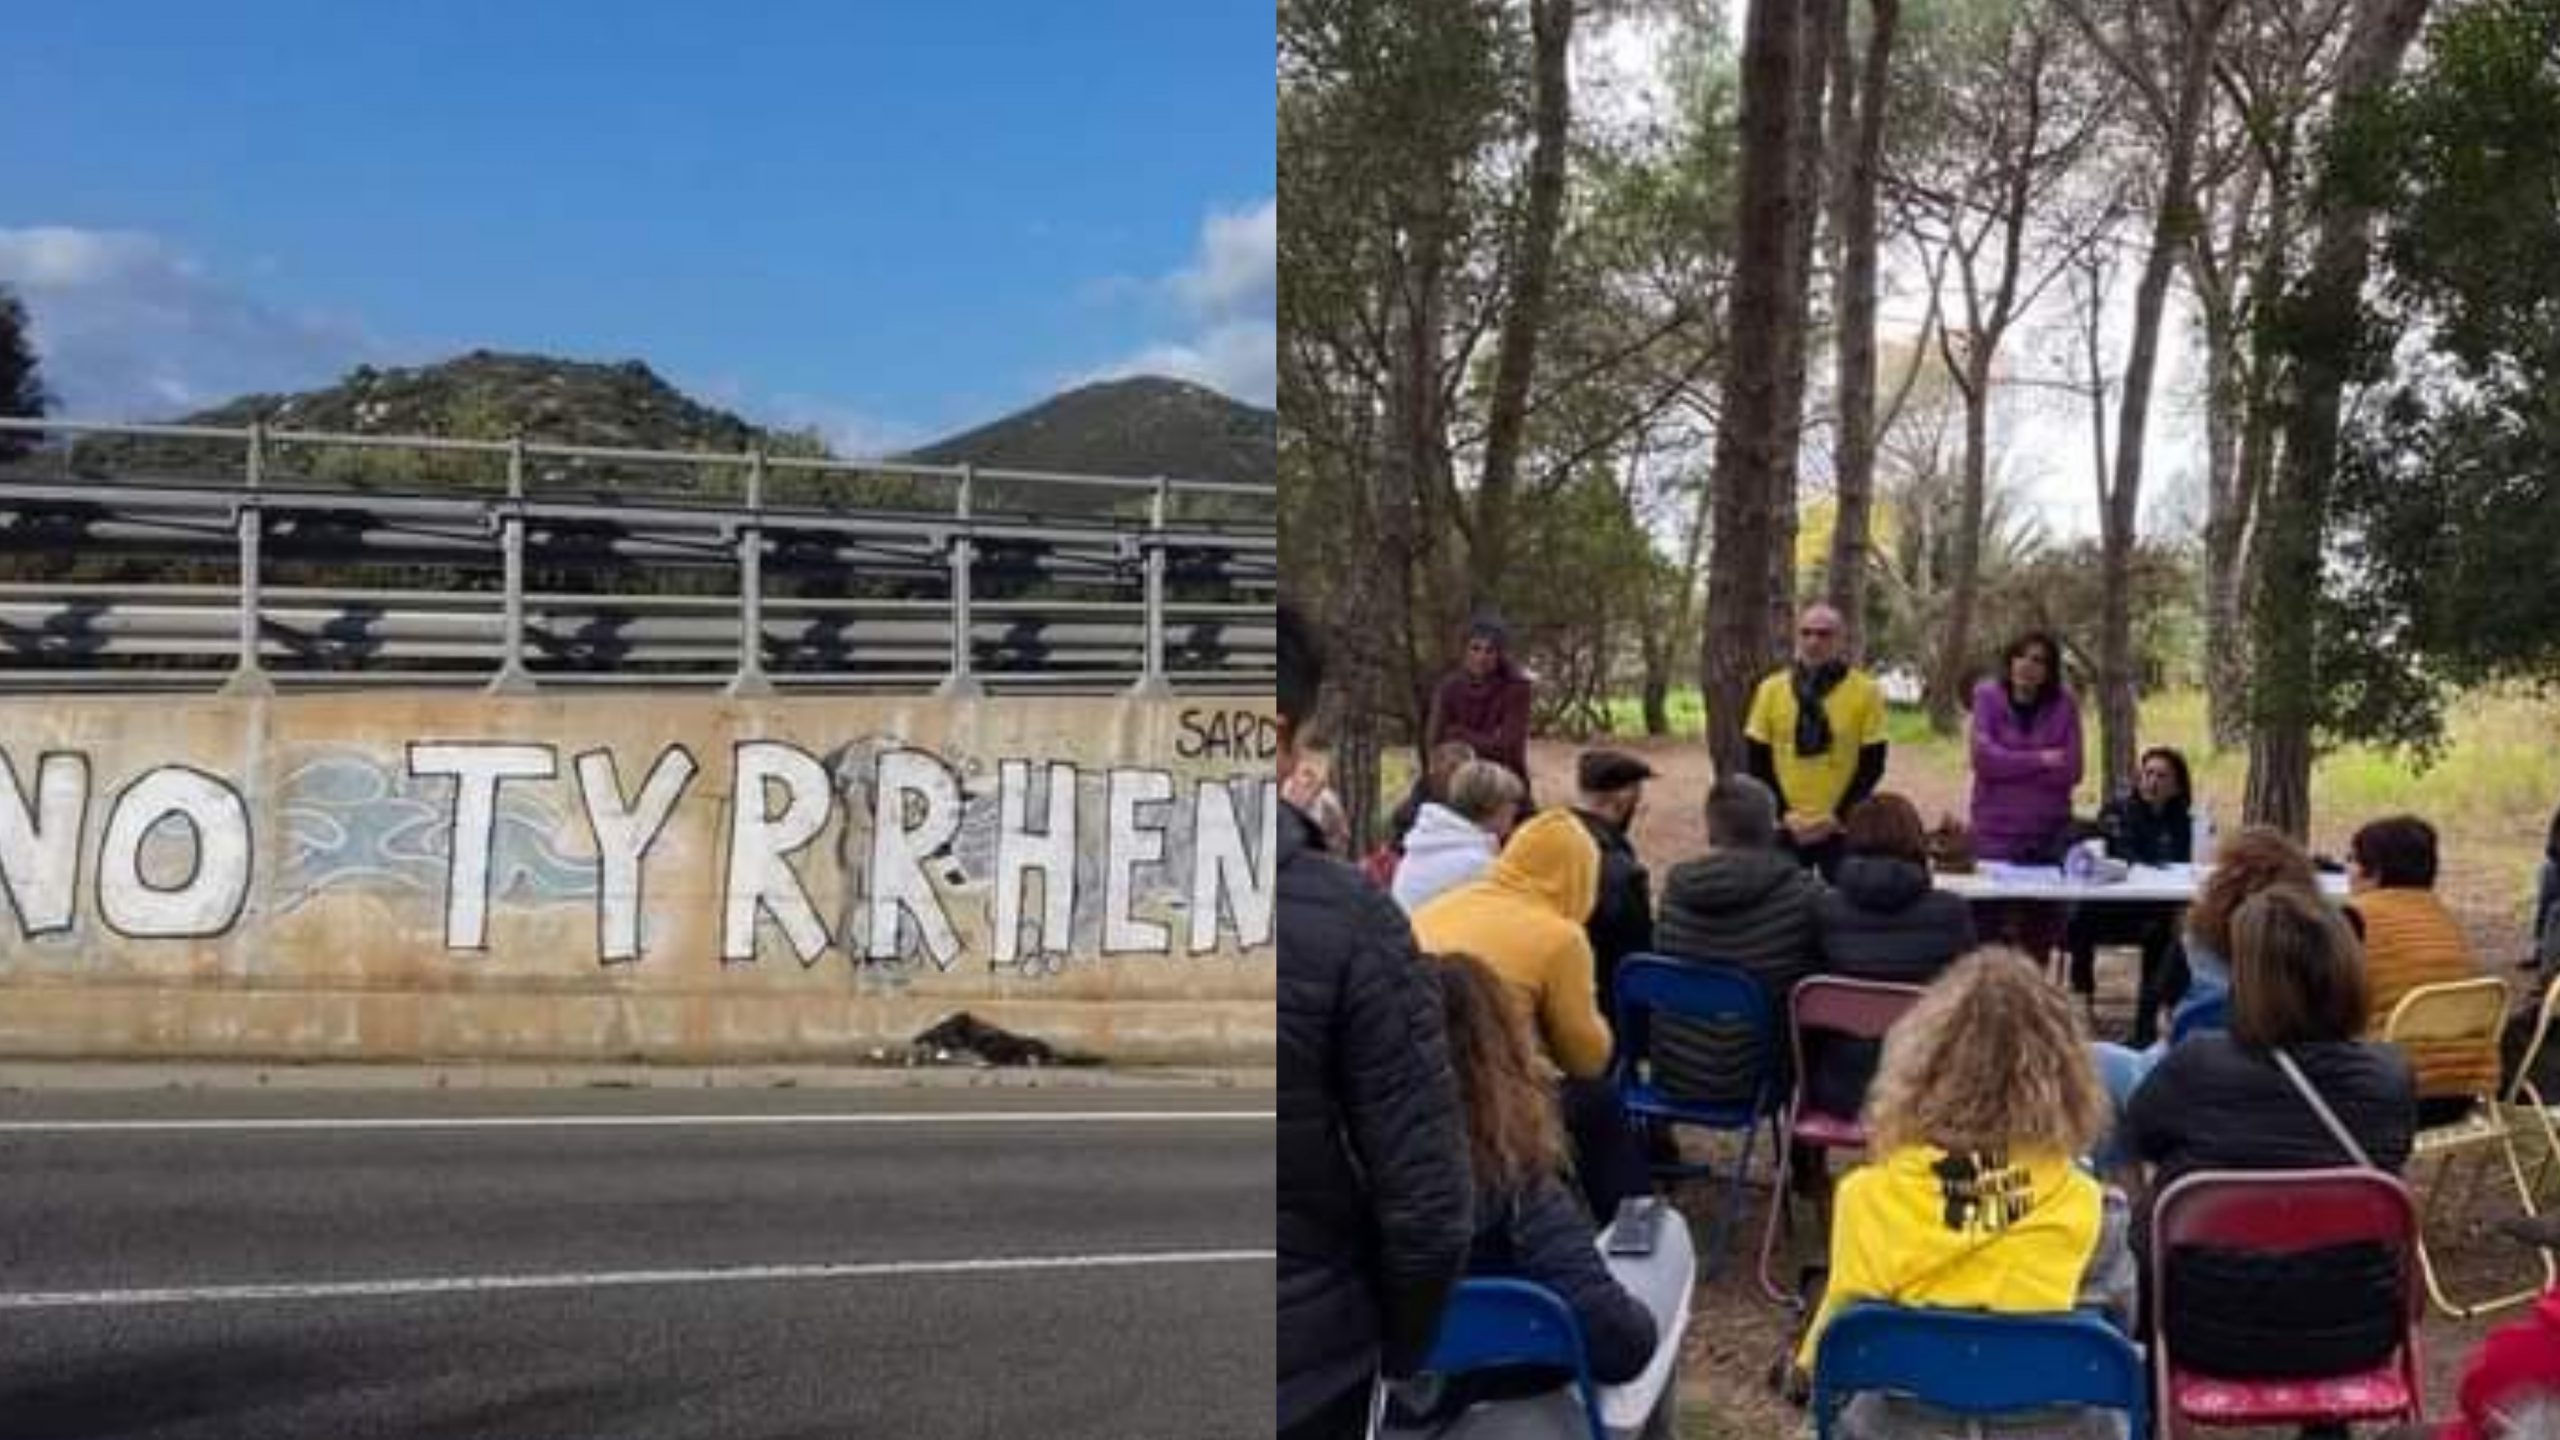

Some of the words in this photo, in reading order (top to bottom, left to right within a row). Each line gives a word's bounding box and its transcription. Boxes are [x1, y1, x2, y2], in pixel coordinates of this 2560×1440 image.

[1176, 708, 1276, 760] SARD
[0, 745, 253, 942] NO
[405, 740, 1276, 971] TYRRHEN
